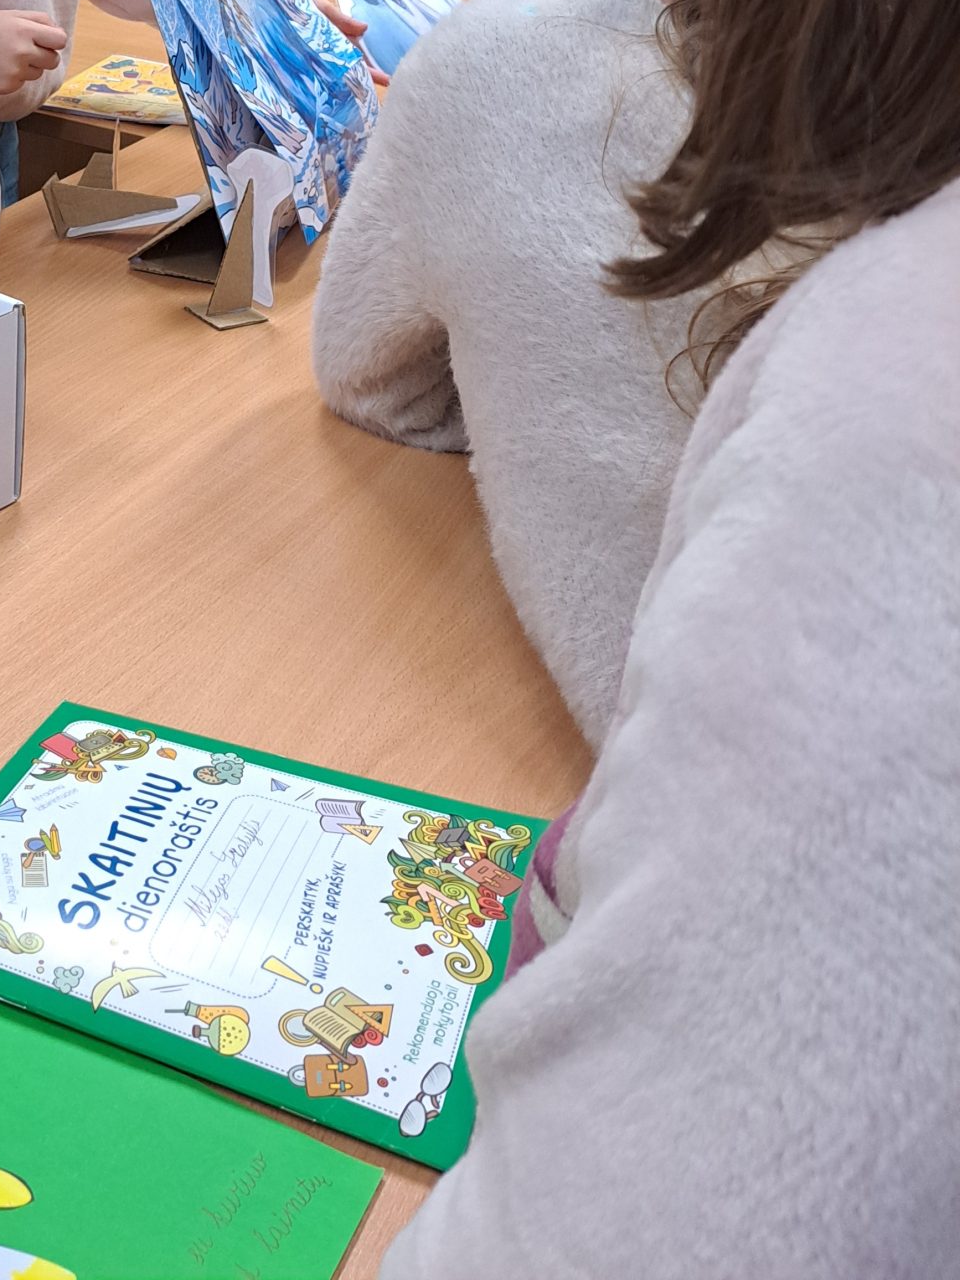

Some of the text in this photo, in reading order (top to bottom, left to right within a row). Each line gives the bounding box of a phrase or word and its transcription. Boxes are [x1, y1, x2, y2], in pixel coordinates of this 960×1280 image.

[58, 772, 193, 930] SKAITINIŲ
[117, 797, 219, 933] dienoraštis
[294, 878, 322, 947] PERSKAITYK,
[313, 859, 348, 980] NUPIEŠK IR APRAŠYK!
[403, 979, 443, 1064] Rekomenduoja
